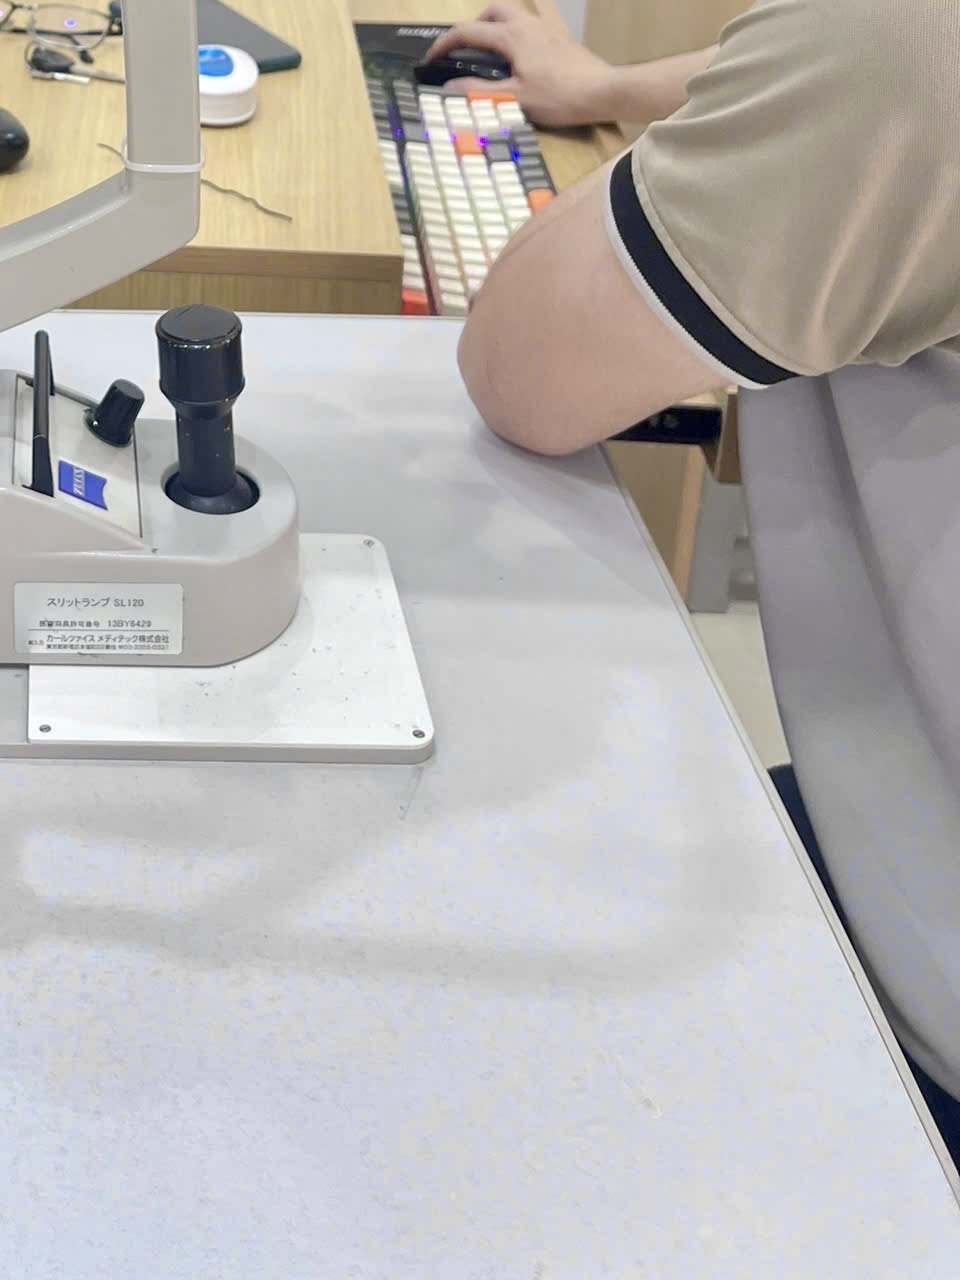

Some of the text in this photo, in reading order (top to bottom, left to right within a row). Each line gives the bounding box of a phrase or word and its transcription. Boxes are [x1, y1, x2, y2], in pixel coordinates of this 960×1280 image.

[47, 597, 145, 607] スリットランプ SL120
